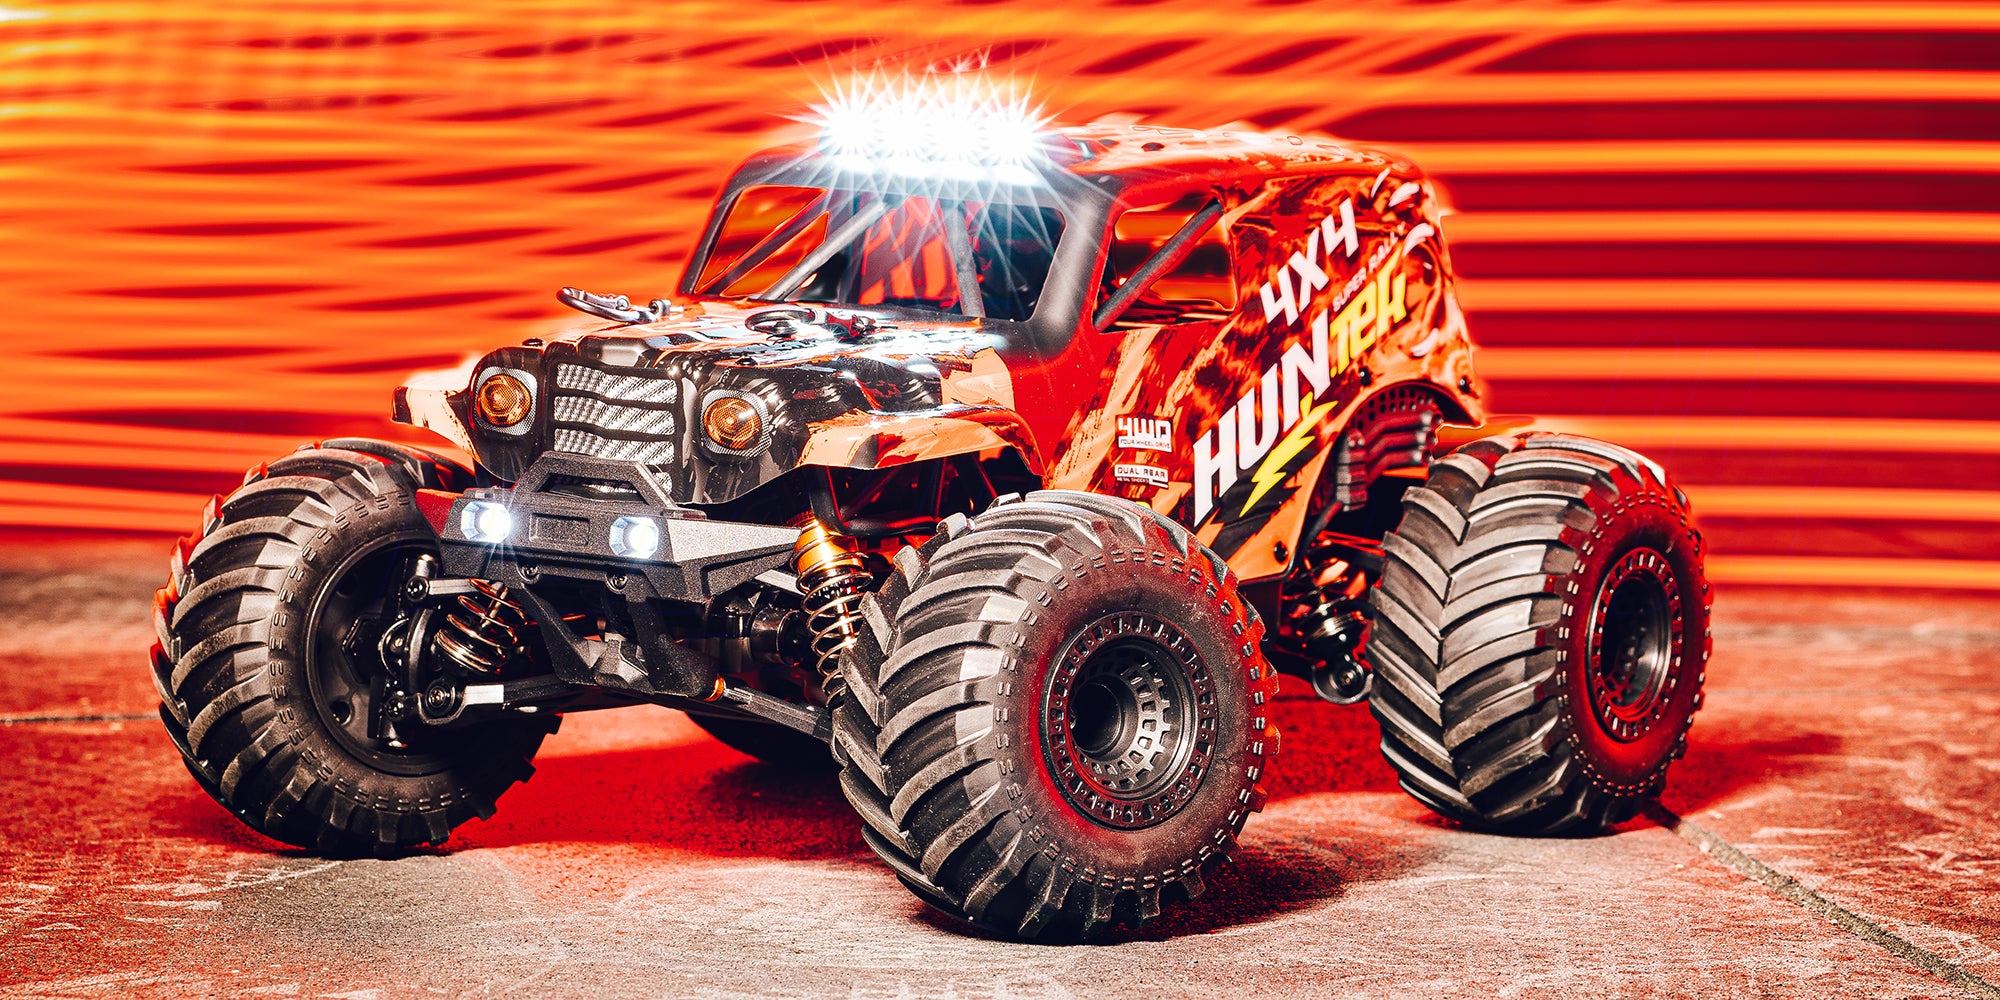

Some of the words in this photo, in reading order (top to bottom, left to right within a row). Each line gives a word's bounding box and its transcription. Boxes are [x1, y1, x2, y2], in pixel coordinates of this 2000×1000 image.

[1260, 198, 1359, 326] 4X4
[1333, 267, 1367, 312] SUPER
[1368, 221, 1406, 274] RALLY
[1118, 417, 1172, 438] 4WD
[1117, 467, 1139, 475] DUAL
[1143, 468, 1166, 478] REAR
